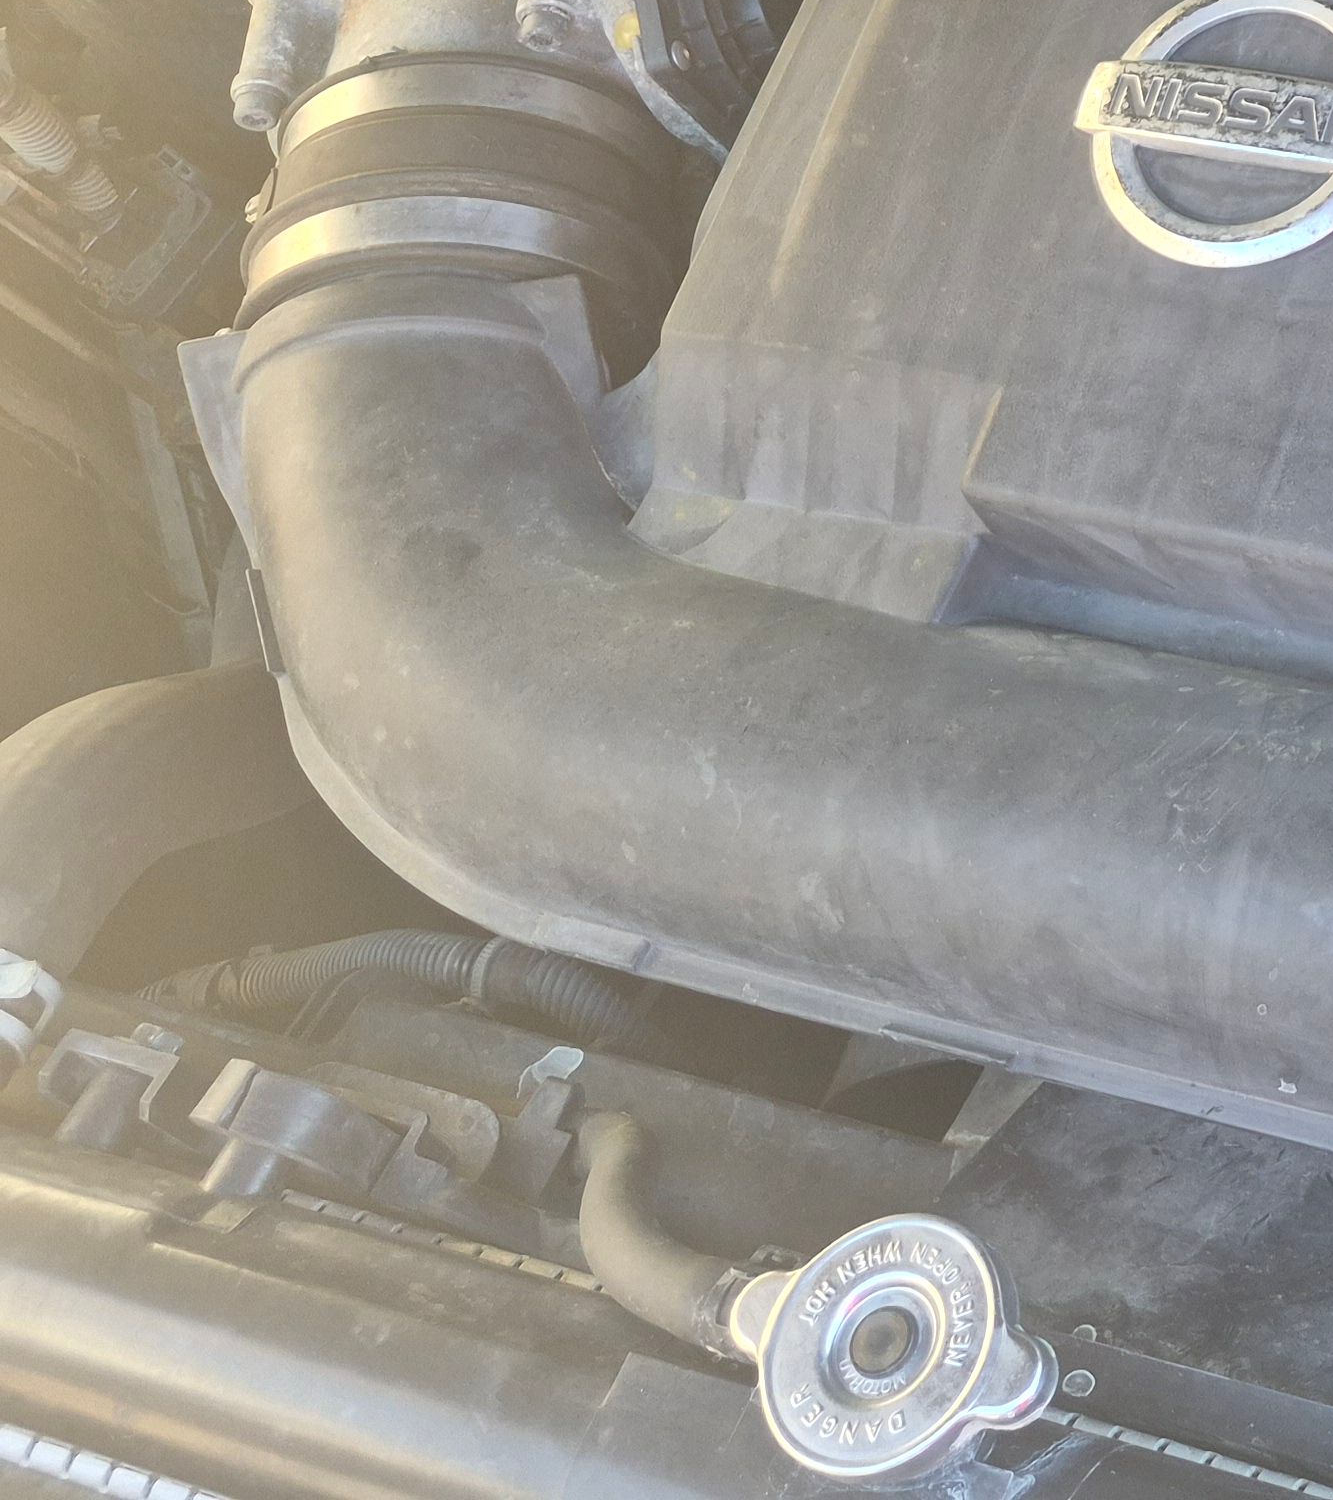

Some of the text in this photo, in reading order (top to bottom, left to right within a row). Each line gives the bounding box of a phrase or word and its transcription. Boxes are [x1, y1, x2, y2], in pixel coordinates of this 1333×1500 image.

[799, 1240, 975, 1366] NEVER OPEN WHEN HOT
[790, 1384, 907, 1445] DANGER
